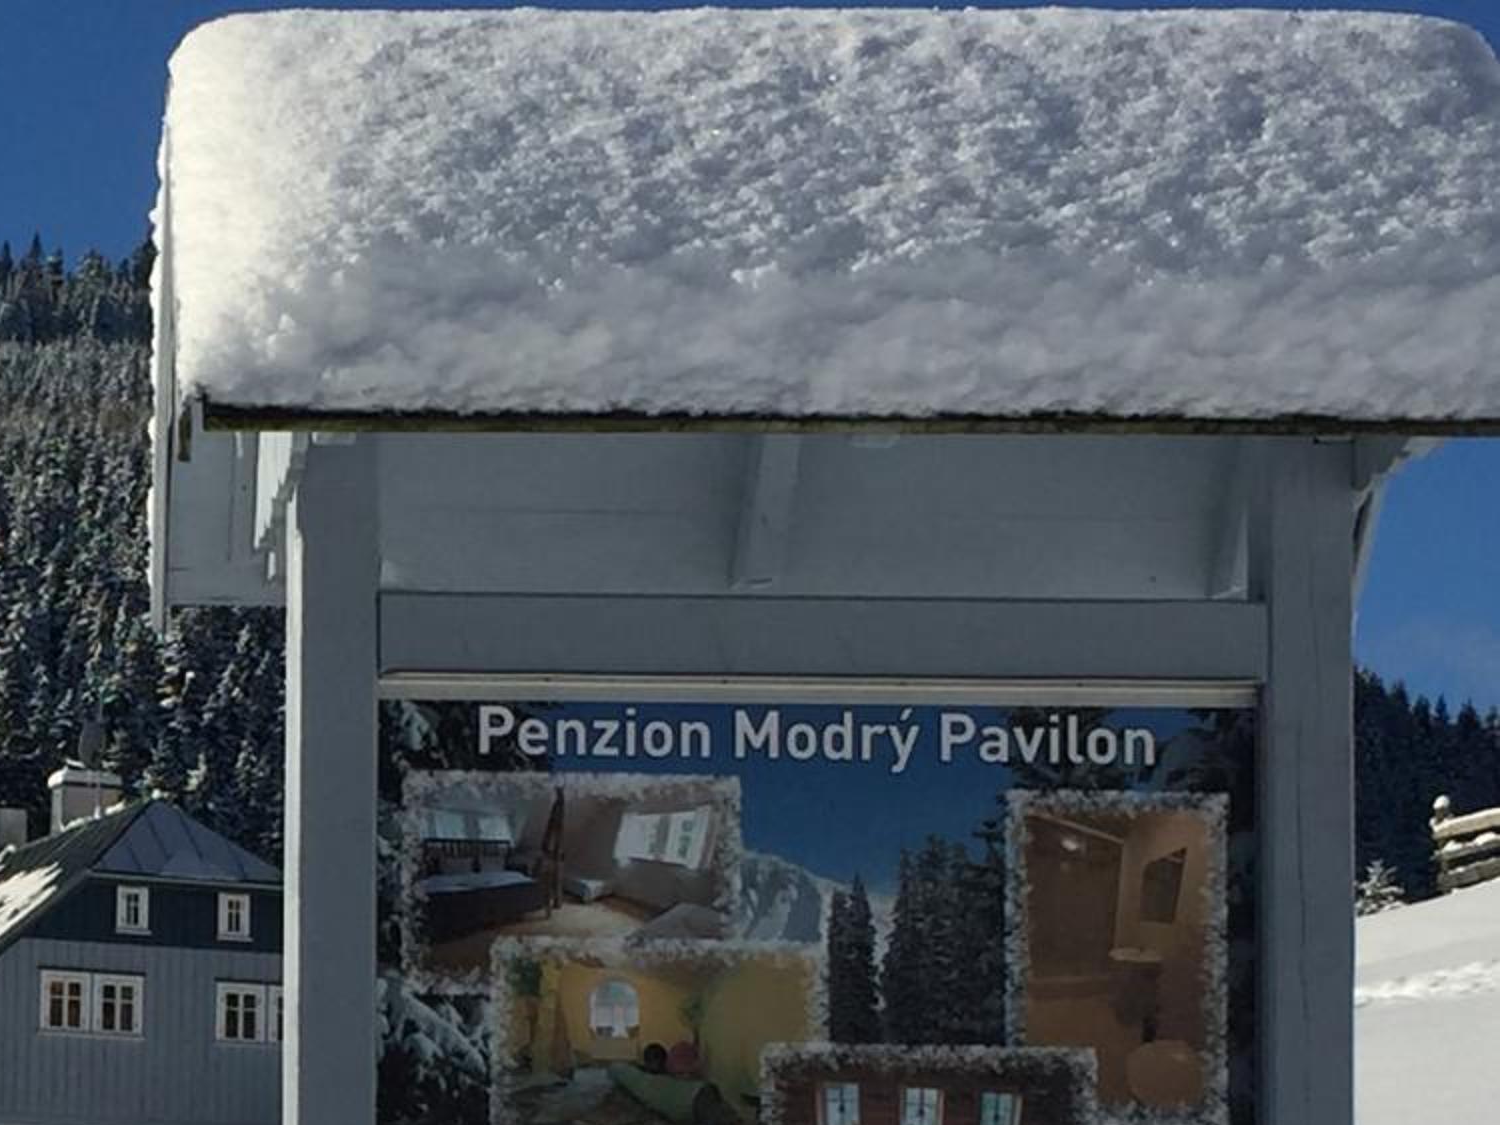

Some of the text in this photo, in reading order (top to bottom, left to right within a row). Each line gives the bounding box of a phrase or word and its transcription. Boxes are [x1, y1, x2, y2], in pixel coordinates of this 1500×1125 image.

[478, 705, 1158, 774] Penzion Modrý Pavilon
